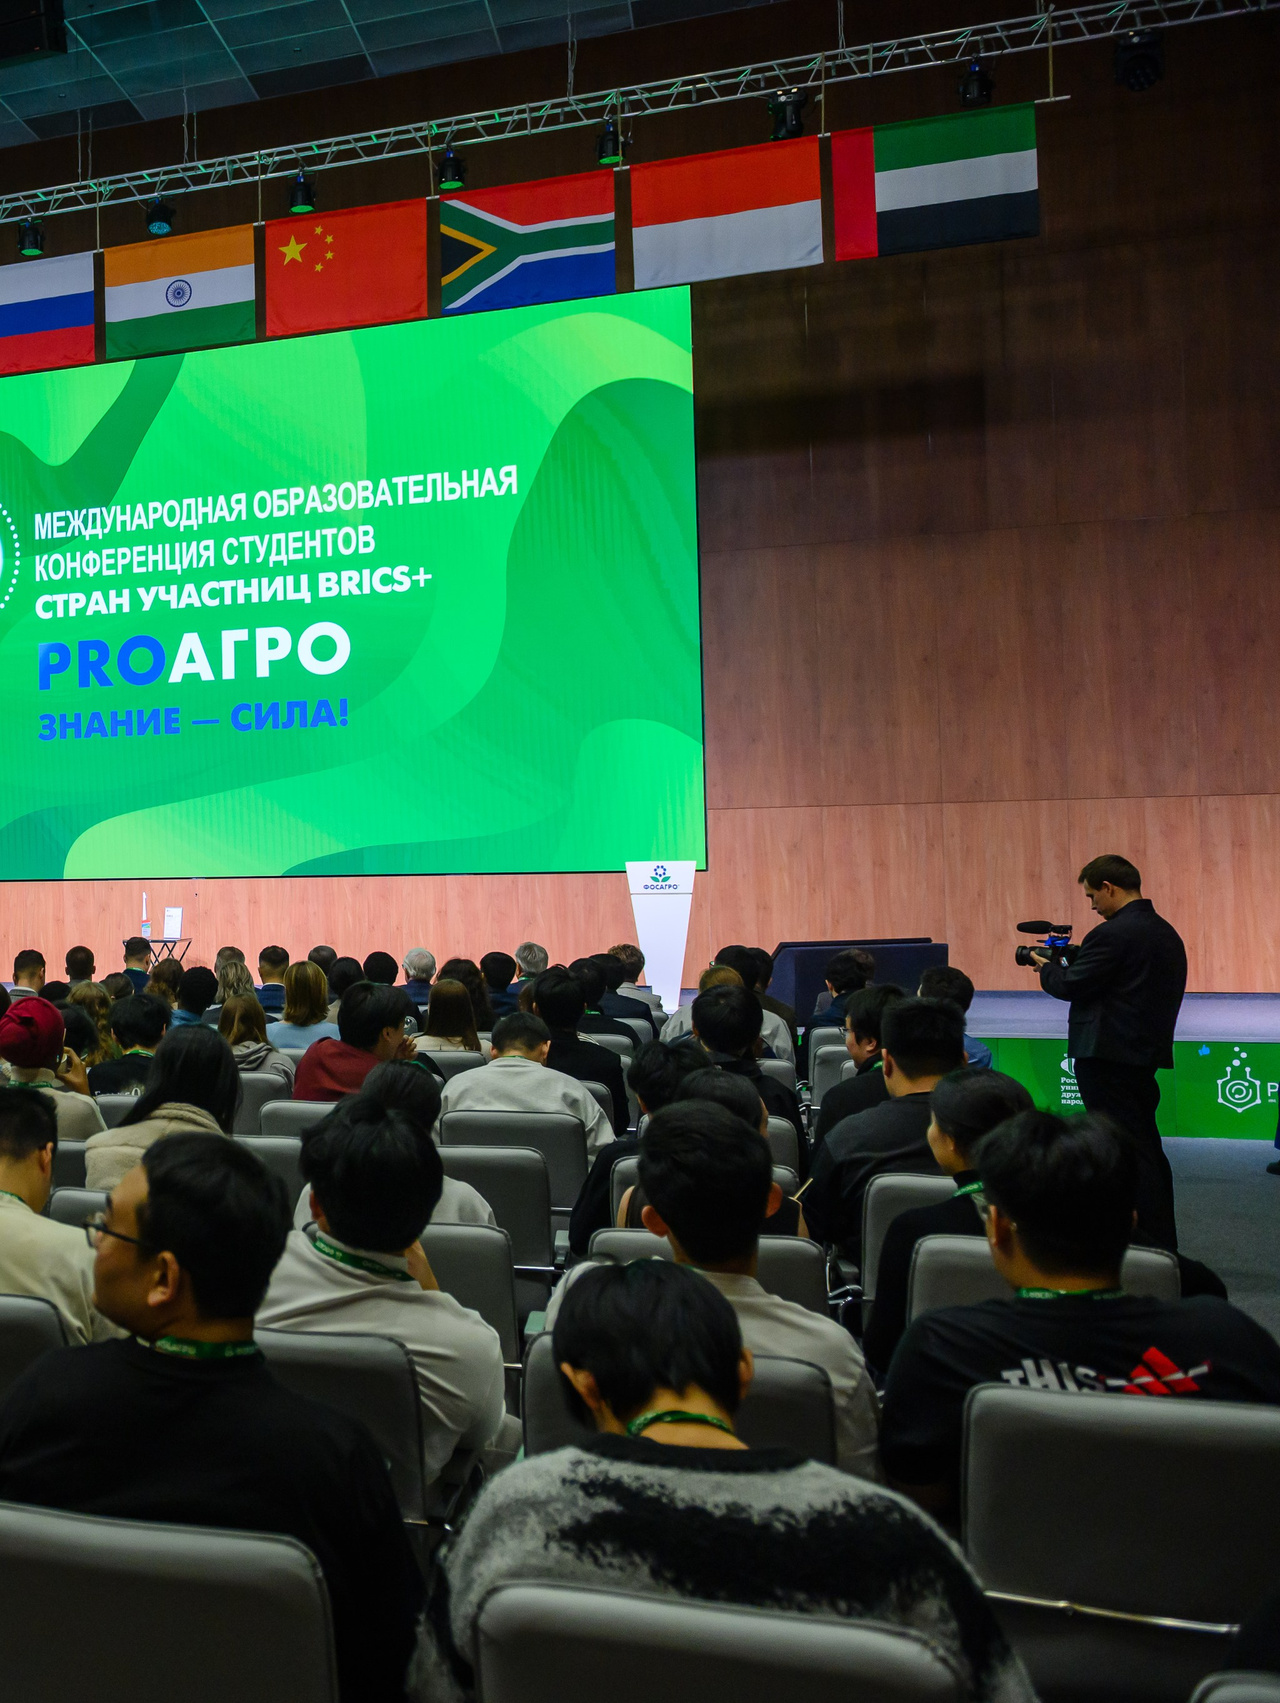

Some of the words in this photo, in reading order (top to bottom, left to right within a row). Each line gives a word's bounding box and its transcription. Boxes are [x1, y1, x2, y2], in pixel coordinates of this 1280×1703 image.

[34, 493, 247, 541] МЕЖДУНАРОДНАЯ
[253, 464, 518, 519] ОБРАЗОВАТЕЛЬНАЯ
[35, 539, 215, 582] КОНФЕРЕНЦИЯ
[222, 524, 376, 568] СТУДЕНТОВ
[35, 588, 130, 620] СТРАН
[136, 574, 312, 612] УЧАСТНИЦ
[318, 565, 433, 598] BRICS+
[38, 707, 181, 741] ЗНАНИЕ
[230, 698, 349, 732] СИЛА!
